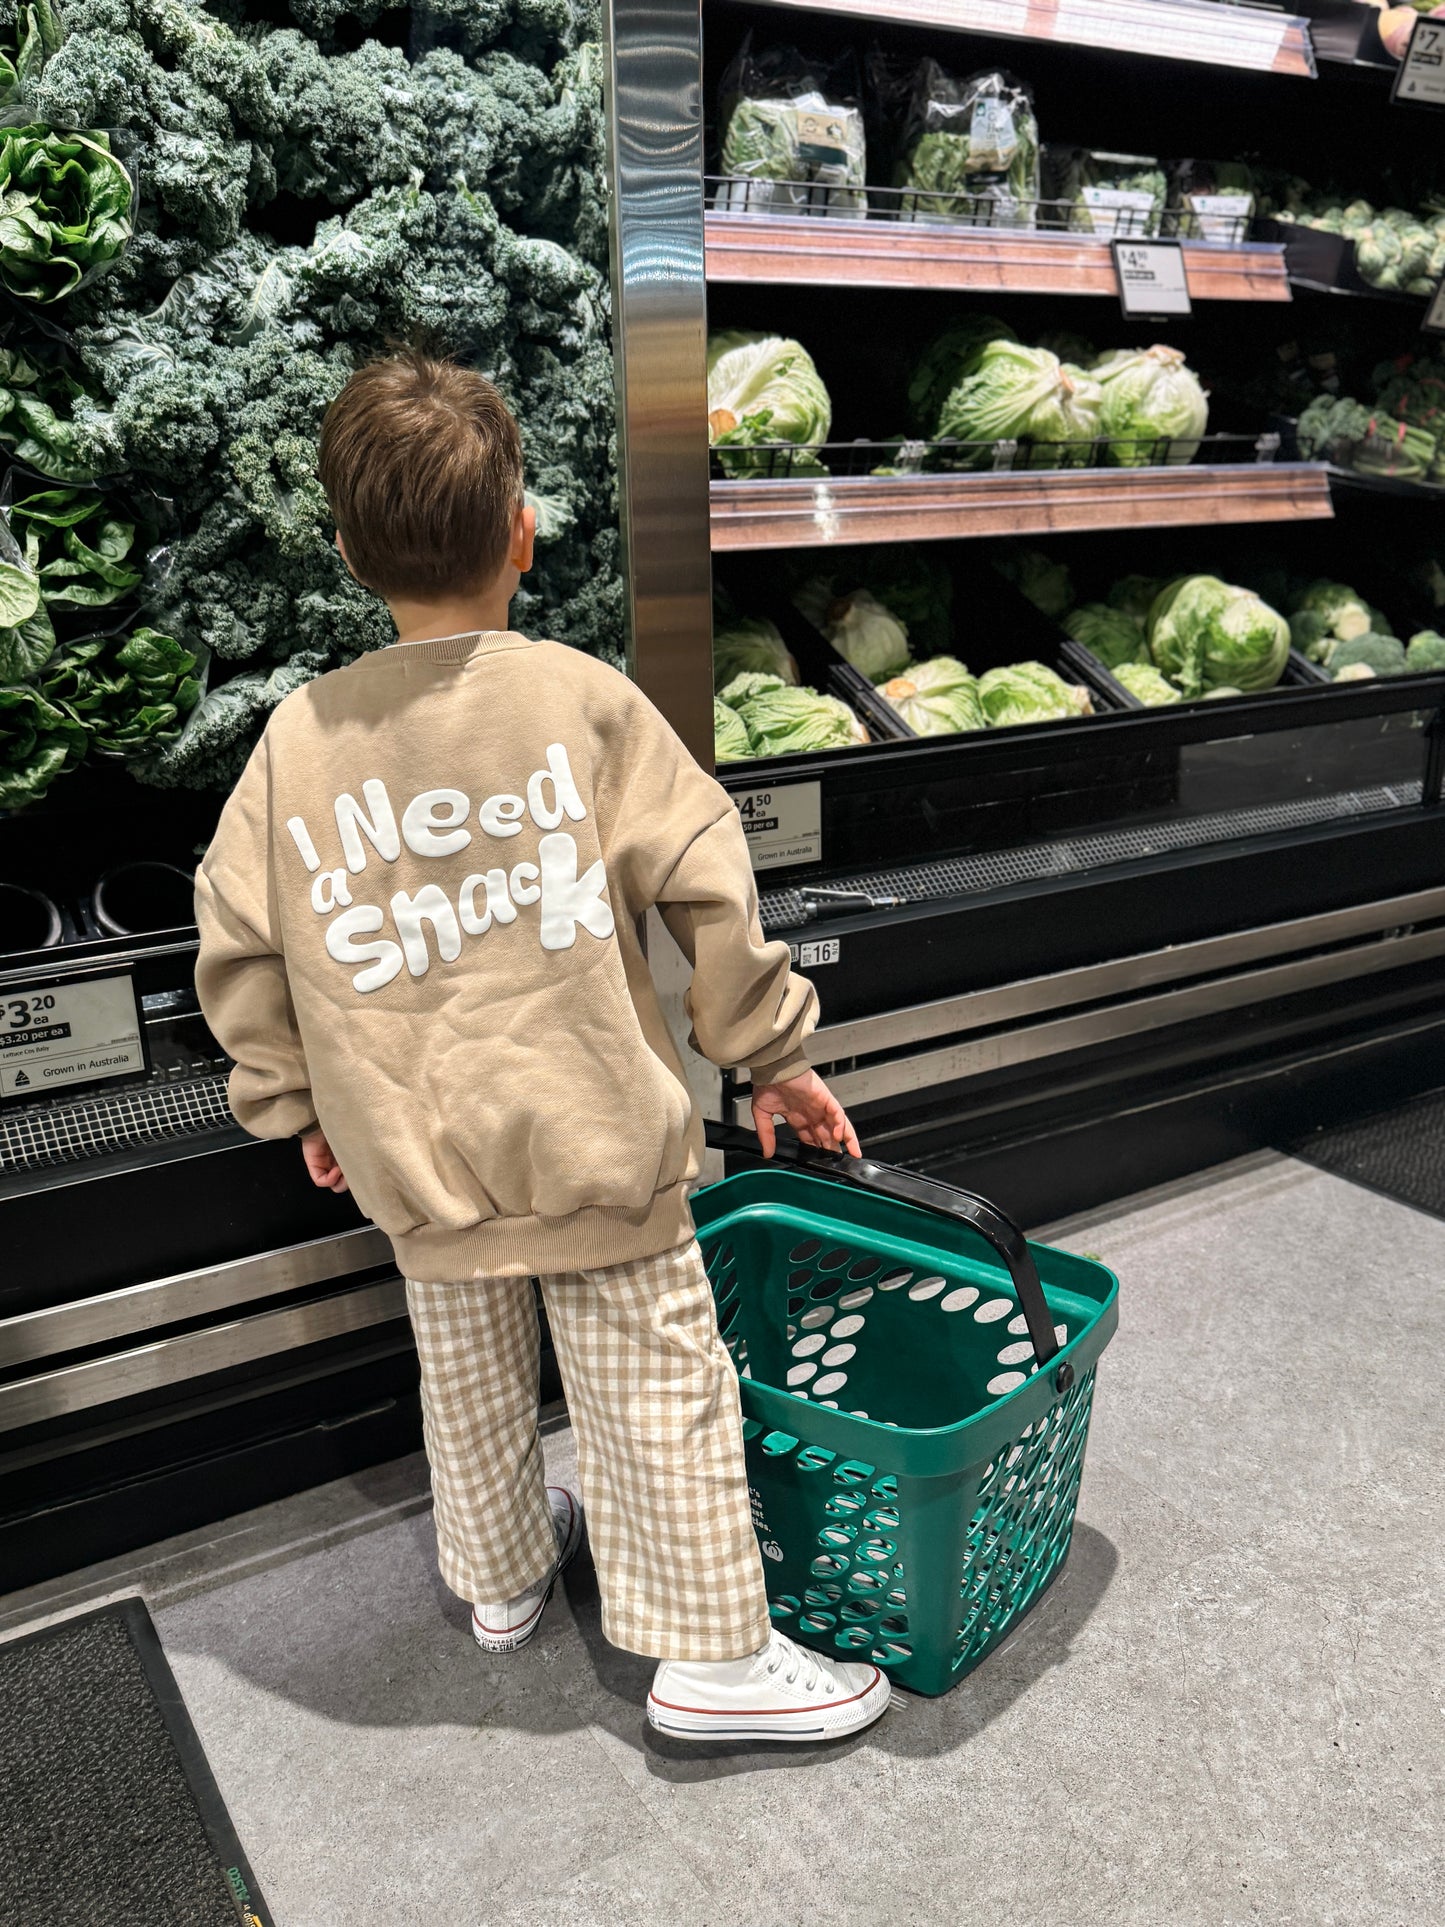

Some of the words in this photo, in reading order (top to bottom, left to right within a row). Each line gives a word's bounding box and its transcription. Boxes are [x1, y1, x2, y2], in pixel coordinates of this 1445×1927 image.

[286, 816, 321, 872] I
[334, 742, 587, 874] Need
[758, 851, 778, 861] Grown
[787, 846, 812, 856] Australia
[310, 868, 353, 914] a
[813, 943, 831, 963] 16
[33, 1015, 49, 1025] ea
[0, 1033, 29, 1048] $3.20
[31, 1031, 49, 1041] per
[51, 1027, 64, 1036] ea
[43, 1065, 75, 1077] Grown
[77, 1062, 87, 1071] in
[89, 1055, 129, 1069] Australia
